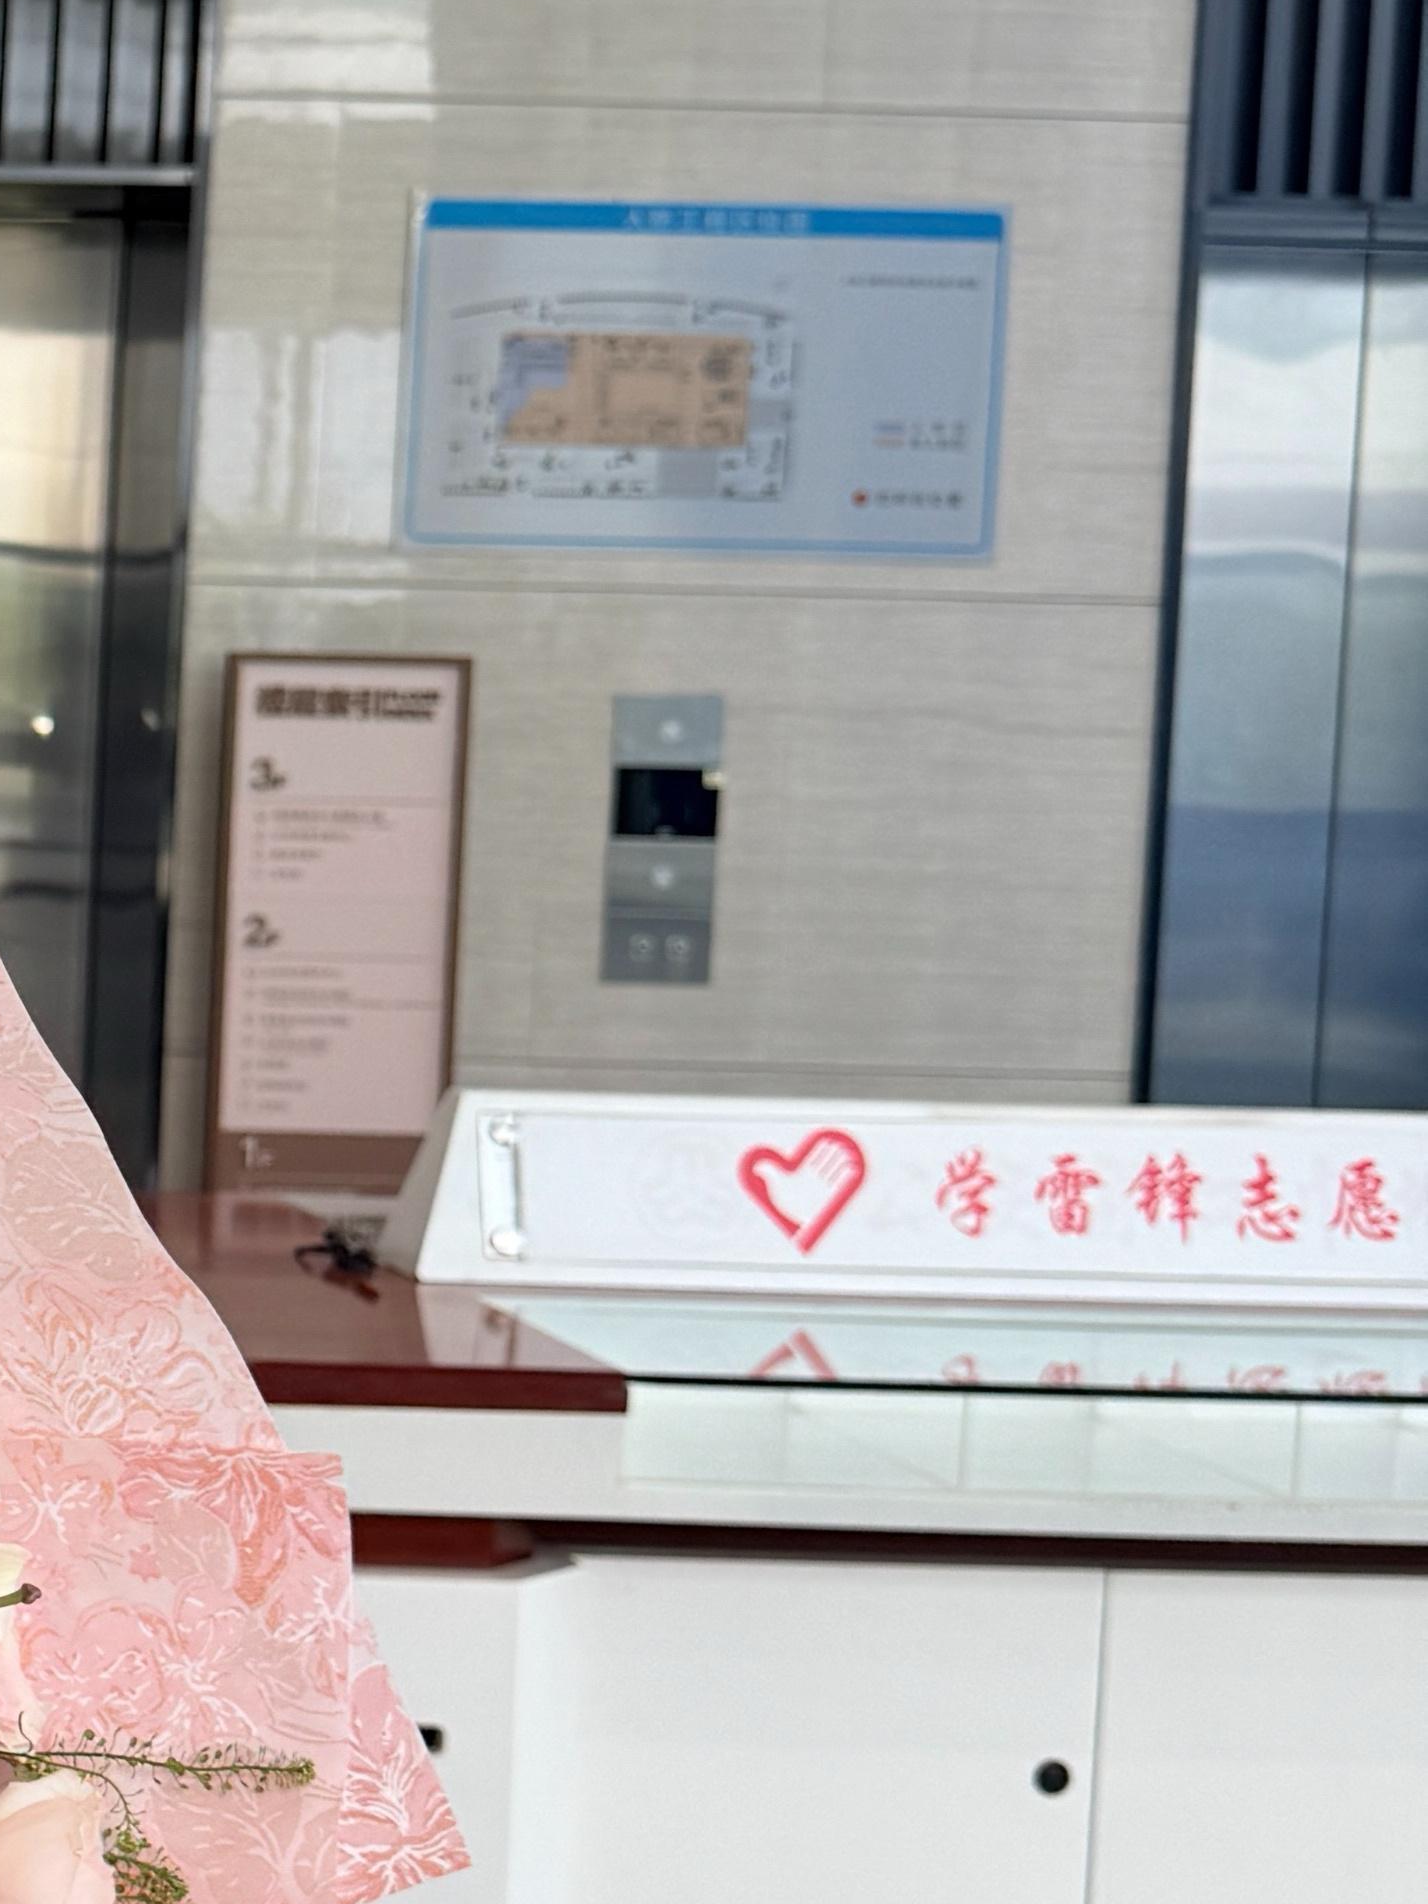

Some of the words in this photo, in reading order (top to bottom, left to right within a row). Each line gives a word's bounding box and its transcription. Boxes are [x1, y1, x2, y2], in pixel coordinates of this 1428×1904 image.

[936, 1149, 1401, 1243] 学雷锋志愿
